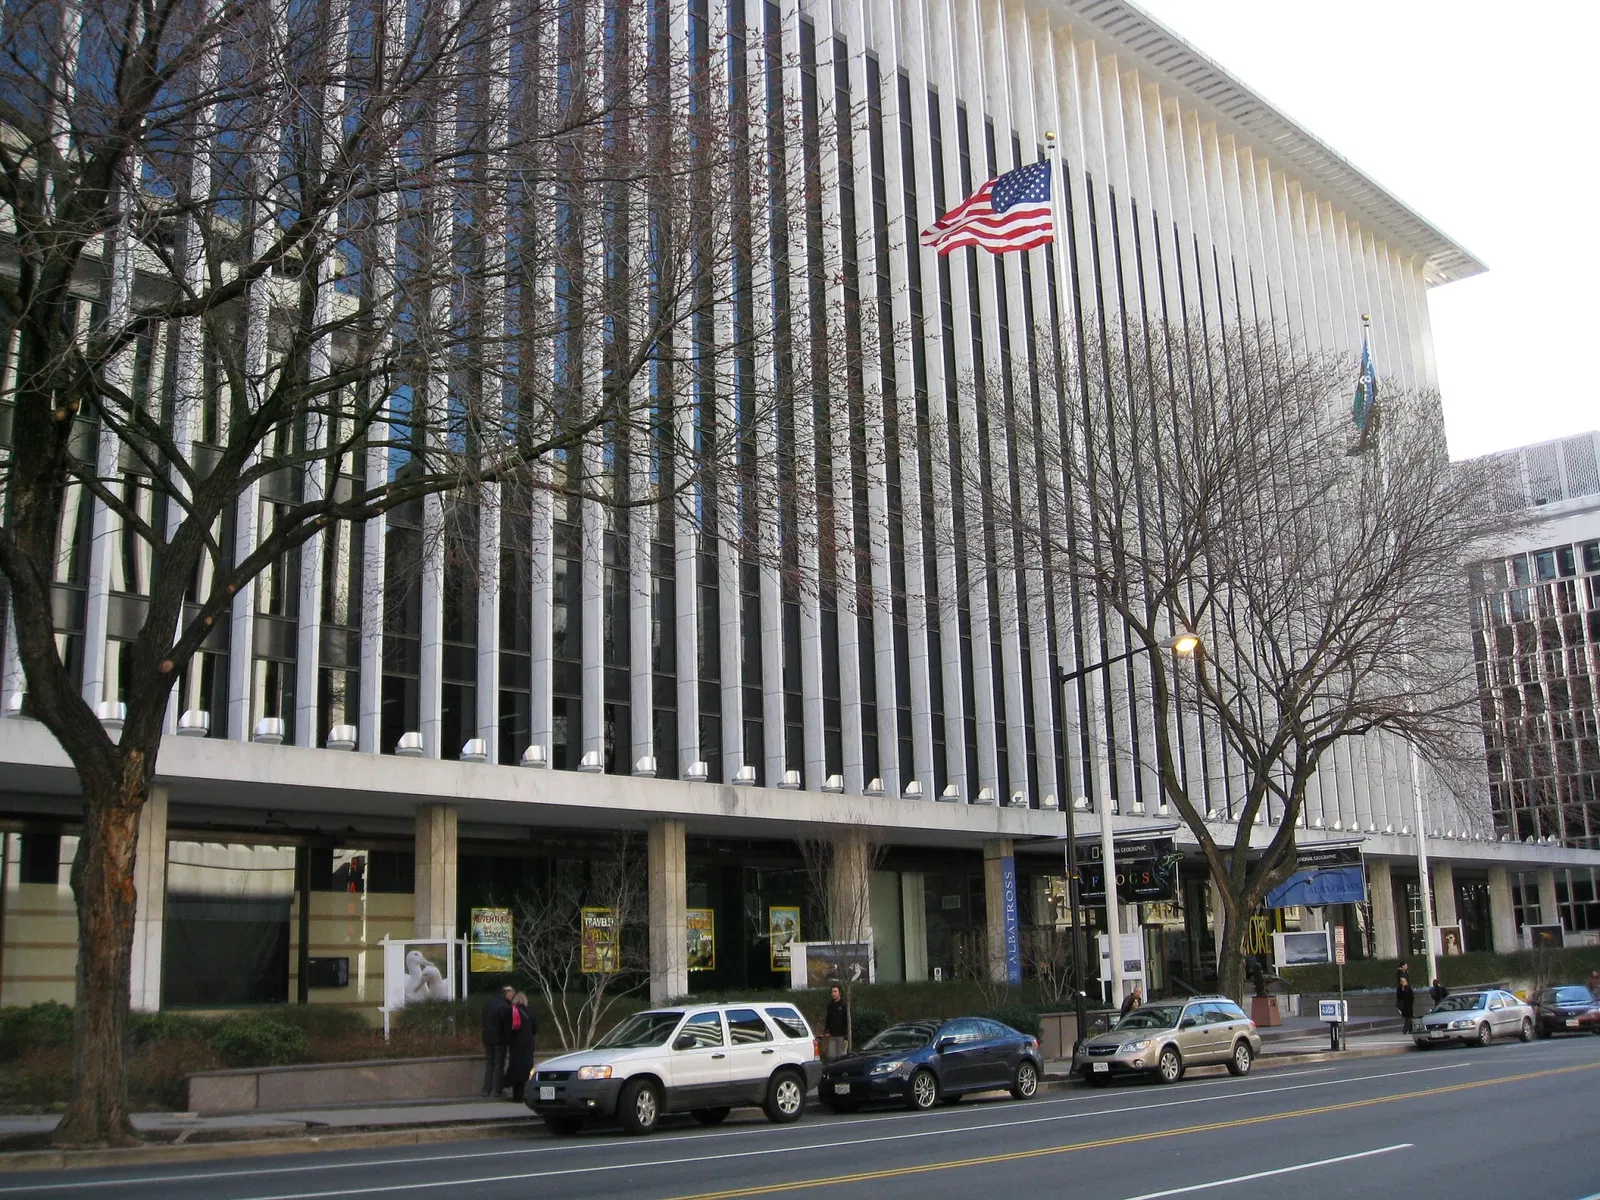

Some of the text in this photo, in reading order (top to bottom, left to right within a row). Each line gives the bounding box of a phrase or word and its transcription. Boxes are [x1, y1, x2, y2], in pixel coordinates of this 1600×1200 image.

[1091, 872, 1150, 887] FOGS
[474, 914, 512, 924] ADVENTURE
[1005, 871, 1017, 965] ALBATROSS
